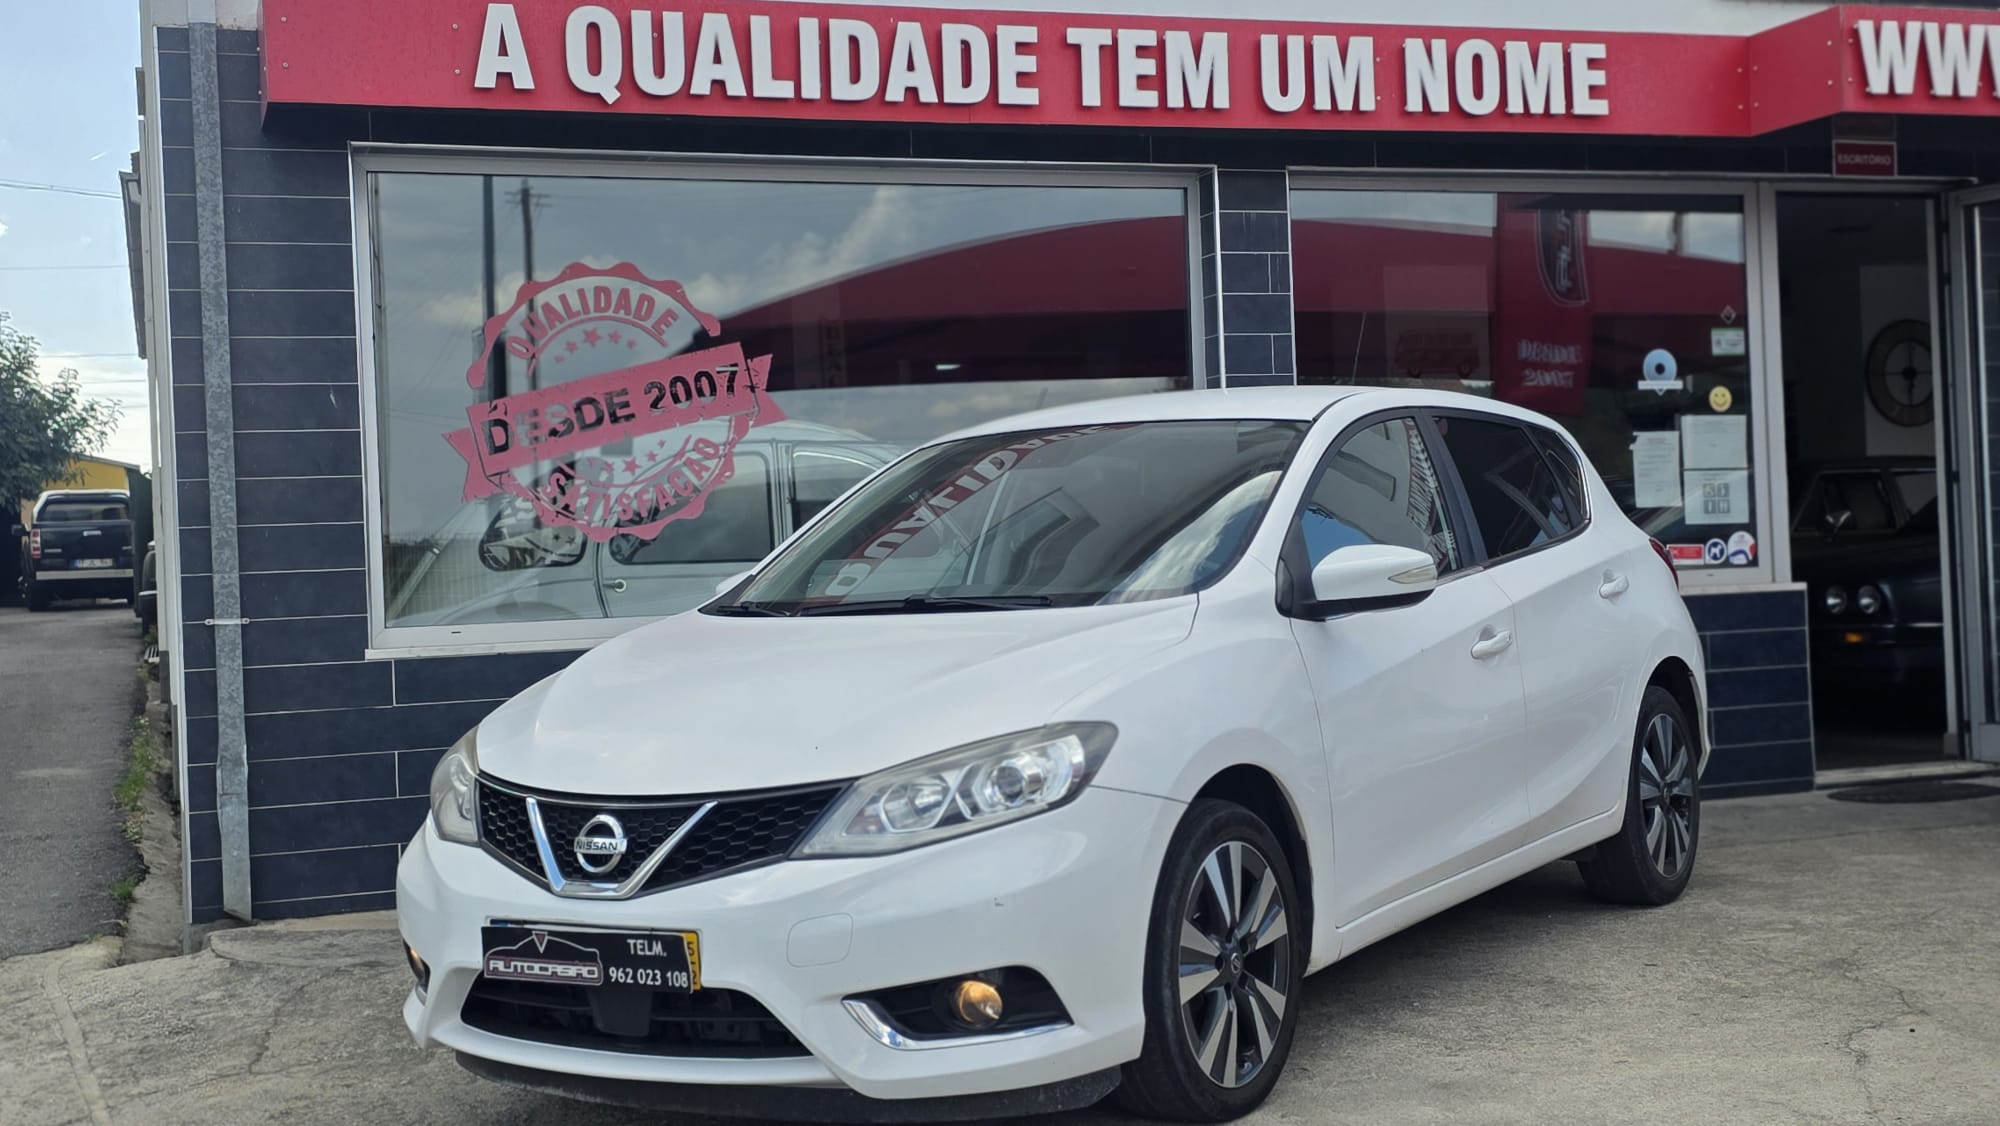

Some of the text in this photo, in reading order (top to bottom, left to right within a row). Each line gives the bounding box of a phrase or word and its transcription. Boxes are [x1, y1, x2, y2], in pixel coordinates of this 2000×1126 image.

[474, 3, 1609, 116] A QUALIDADE TEM UM NOME
[1857, 19, 2000, 98] WW
[506, 285, 679, 361] QUALIDADE
[480, 362, 739, 456] DESDE 2007
[575, 839, 618, 851] NISSAN
[609, 966, 689, 988] 962 023 108
[627, 938, 667, 958] TELM.
